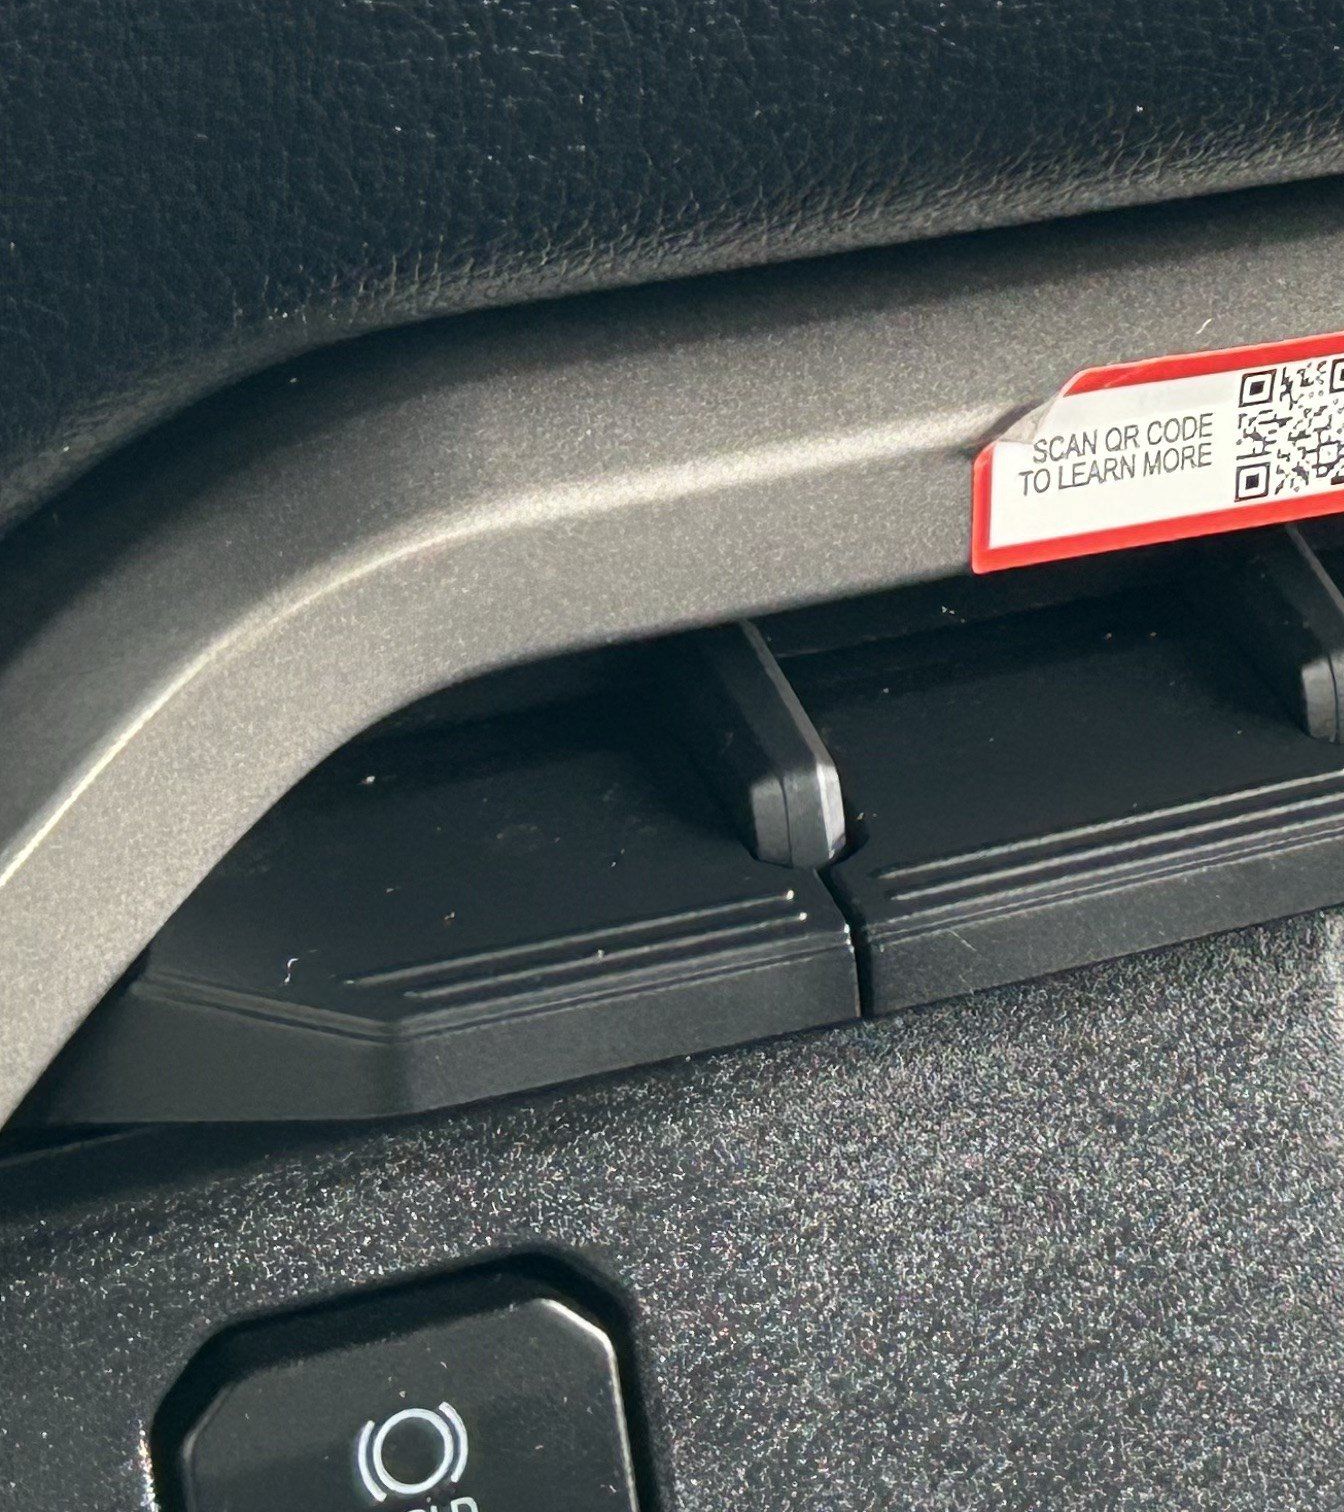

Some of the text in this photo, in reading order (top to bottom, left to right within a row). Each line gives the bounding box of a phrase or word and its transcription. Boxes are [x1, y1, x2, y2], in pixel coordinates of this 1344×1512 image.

[1033, 413, 1213, 464] SCAN QR CODE
[1018, 443, 1212, 496] TO LEARN MORE
